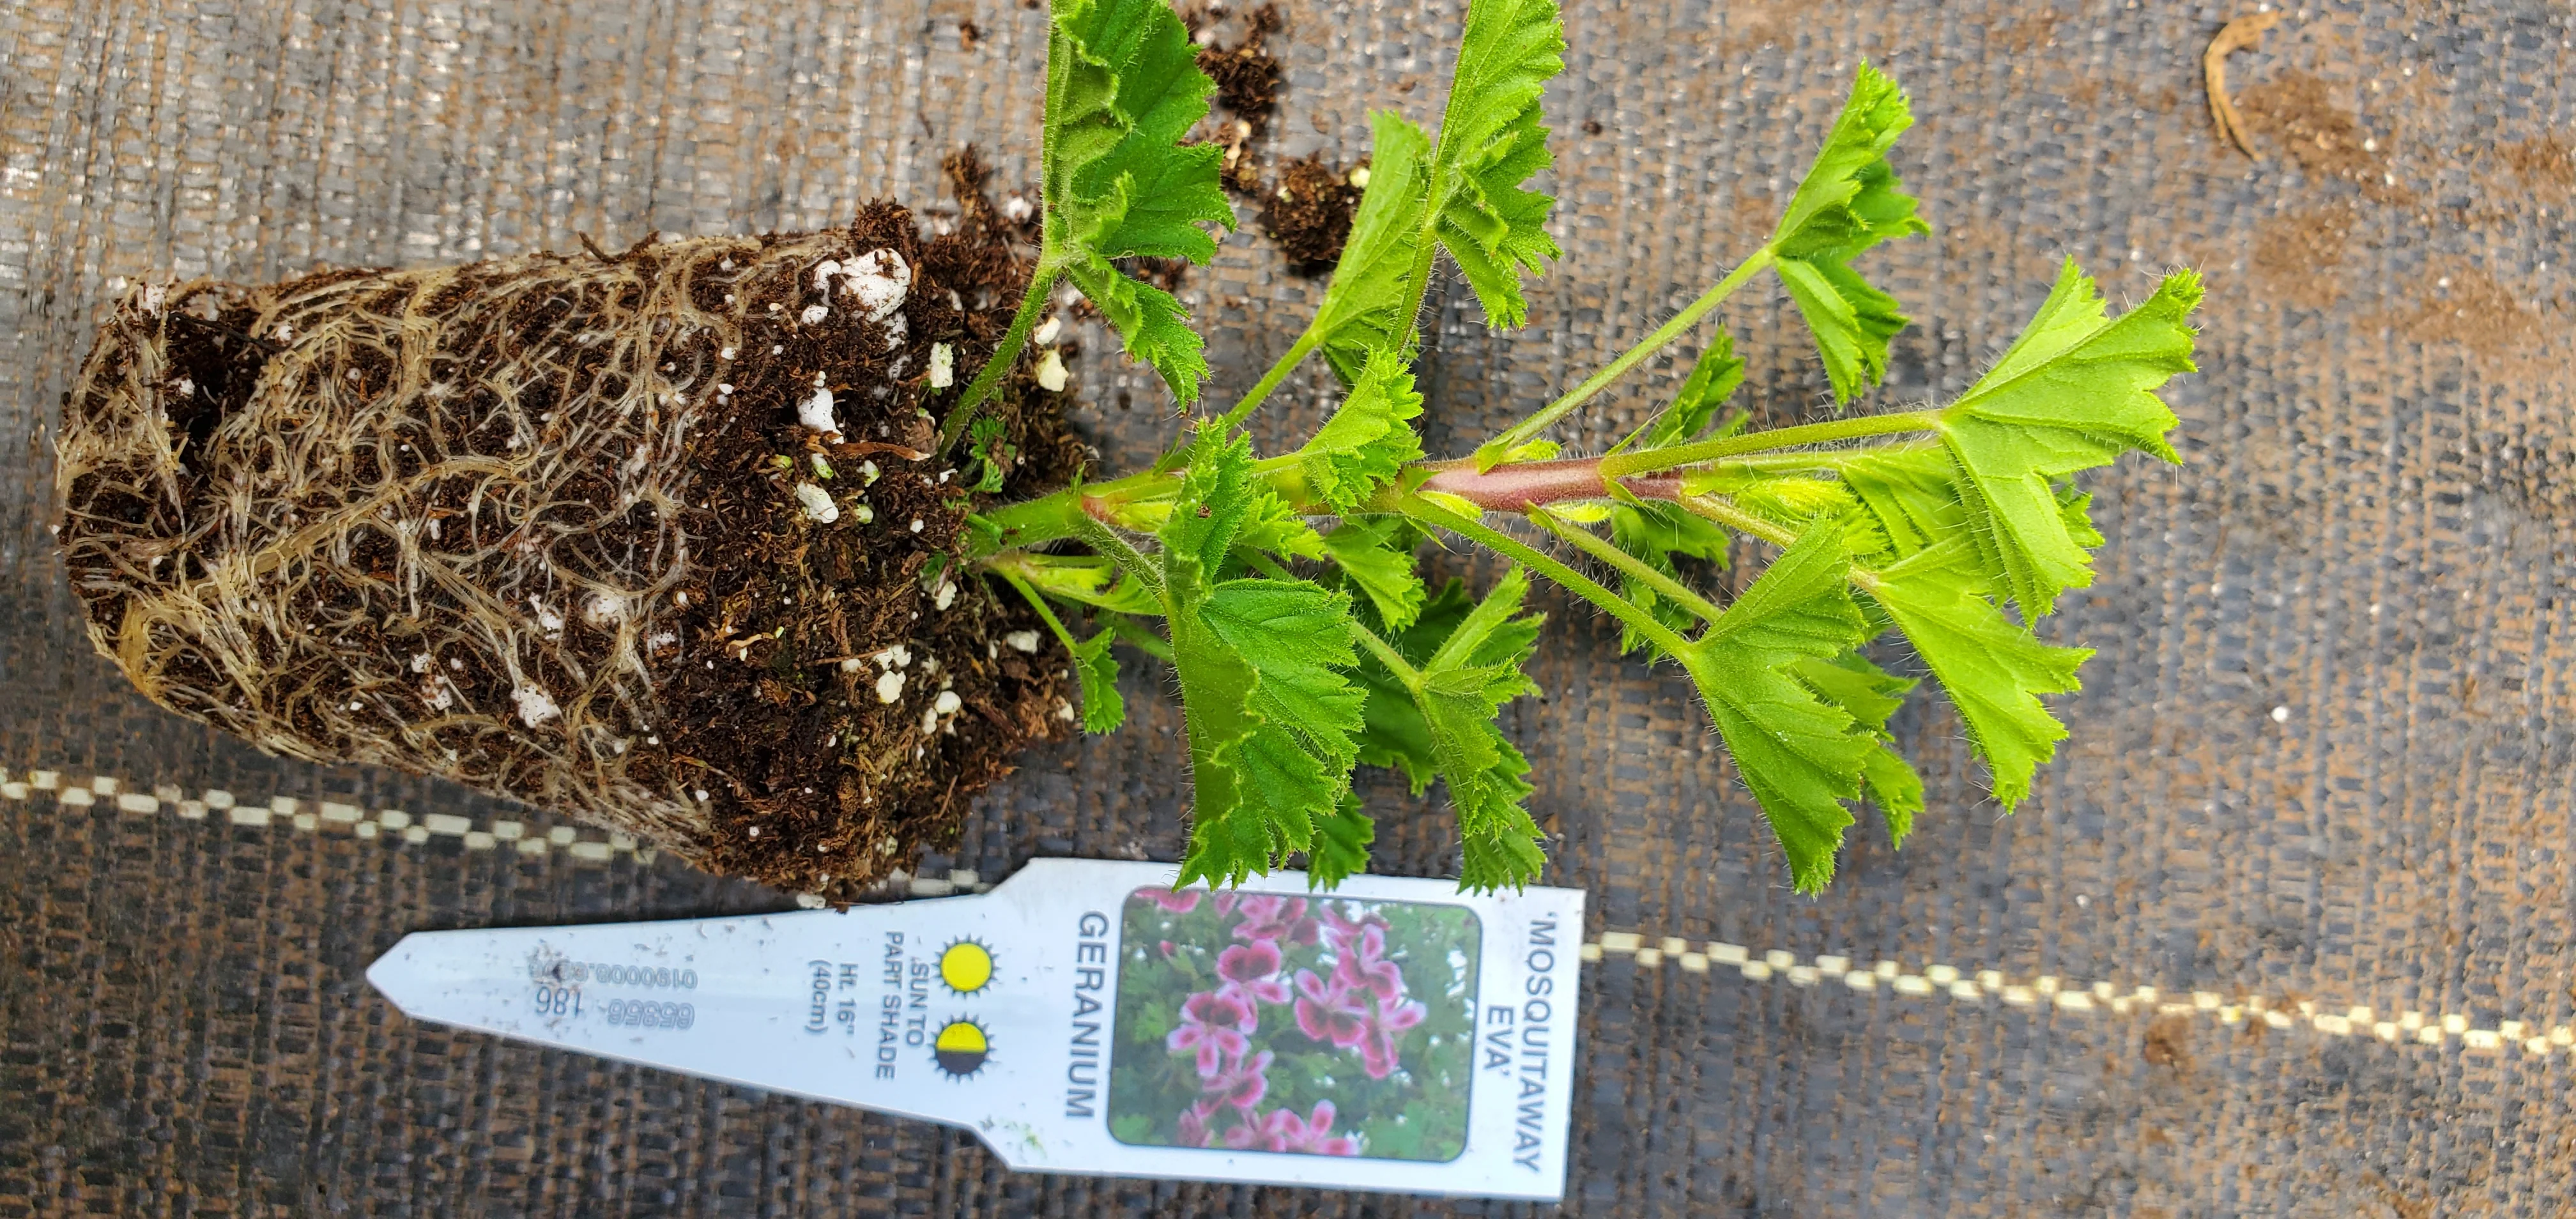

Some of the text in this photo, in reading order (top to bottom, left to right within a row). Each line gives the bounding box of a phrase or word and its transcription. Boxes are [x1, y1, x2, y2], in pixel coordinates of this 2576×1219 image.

[535, 985, 584, 1018] 186
[805, 959, 832, 1034] (40cm)
[838, 962, 859, 990] Ht.
[875, 930, 905, 1080] PART SHADE
[906, 1013, 927, 1047] TO
[1066, 910, 1109, 1118] GERANIUM
